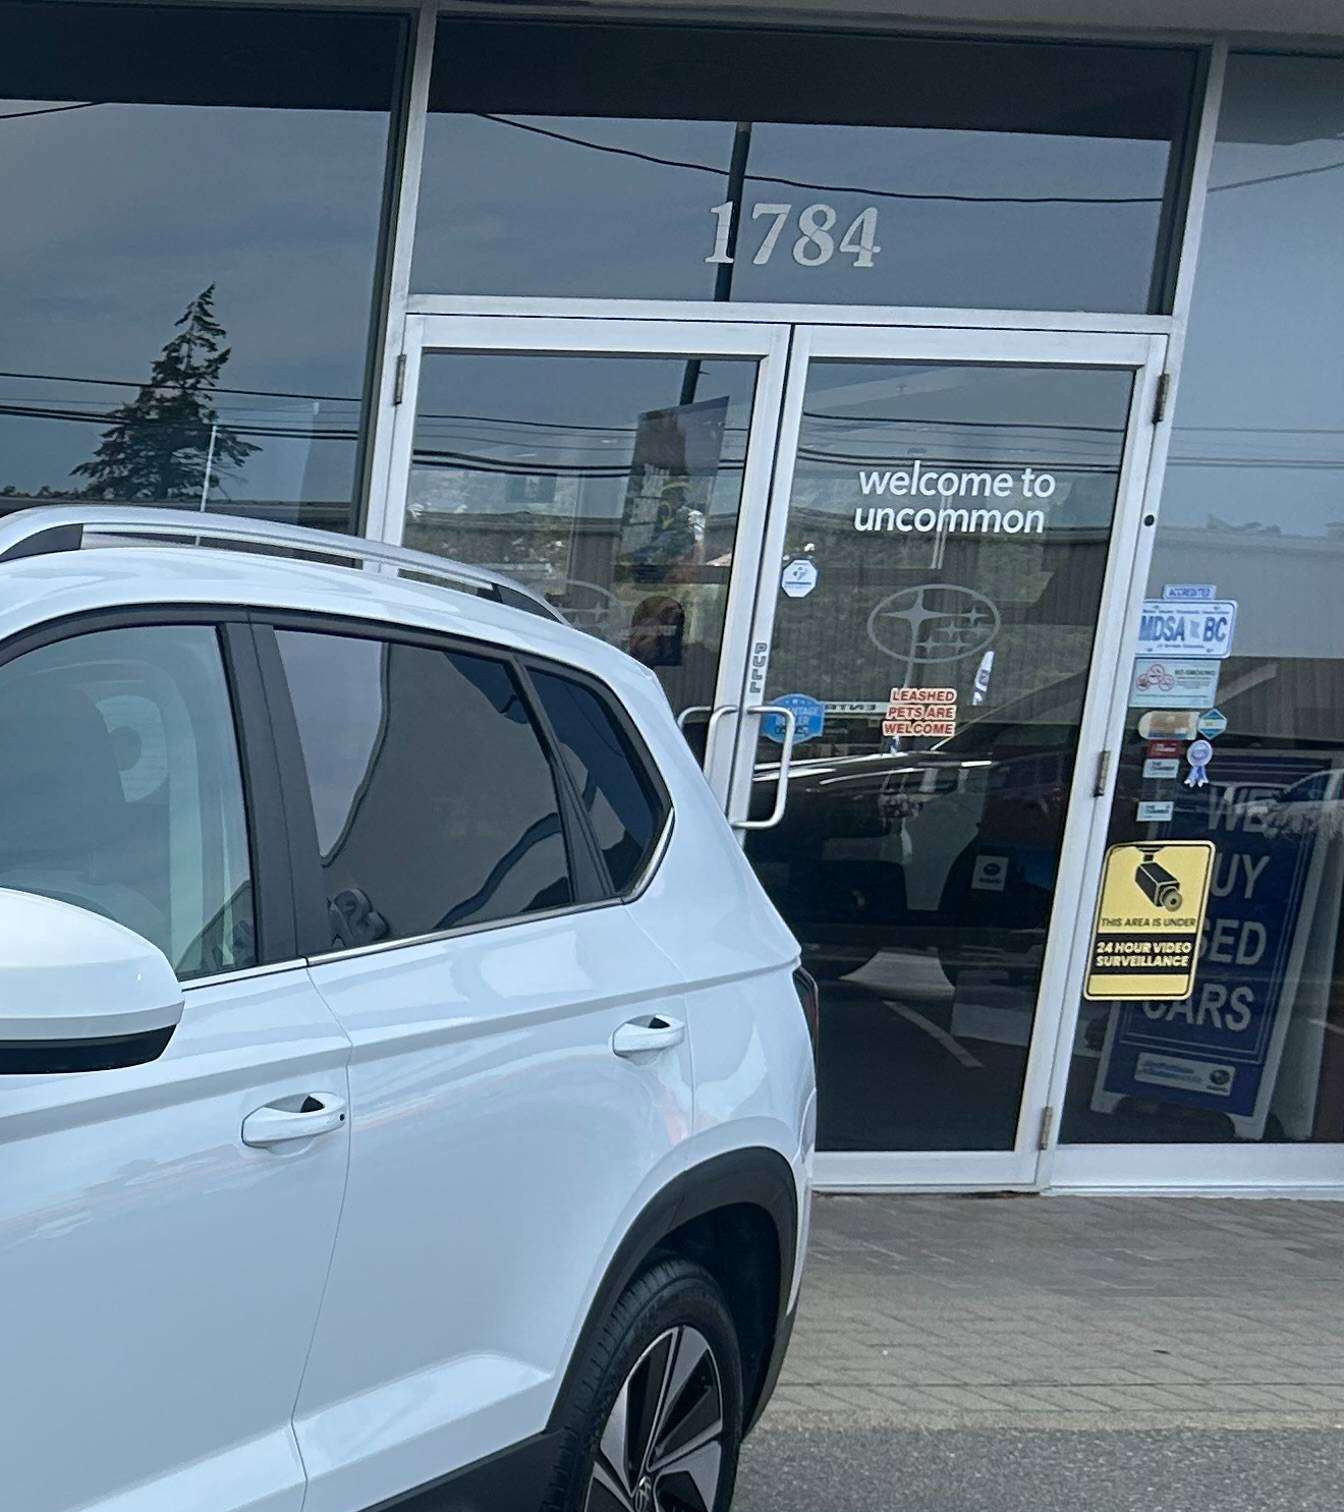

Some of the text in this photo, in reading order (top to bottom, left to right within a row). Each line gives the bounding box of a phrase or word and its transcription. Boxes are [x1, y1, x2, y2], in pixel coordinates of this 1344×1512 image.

[704, 200, 881, 268] 1784
[859, 459, 1056, 498] welcome to
[853, 505, 1045, 534] uncommon
[1202, 616, 1227, 642] BC
[749, 642, 768, 694] PULL
[892, 691, 955, 703] LEASHED
[887, 705, 954, 719] PETS ARE
[883, 722, 954, 735] WELCOME
[1212, 852, 1270, 900] UY
[1101, 917, 1196, 927] THIS AREA IS UNDER
[1096, 942, 1192, 954] 24 HOUR VIDEO
[1096, 955, 1190, 967] SURVEILLANCE
